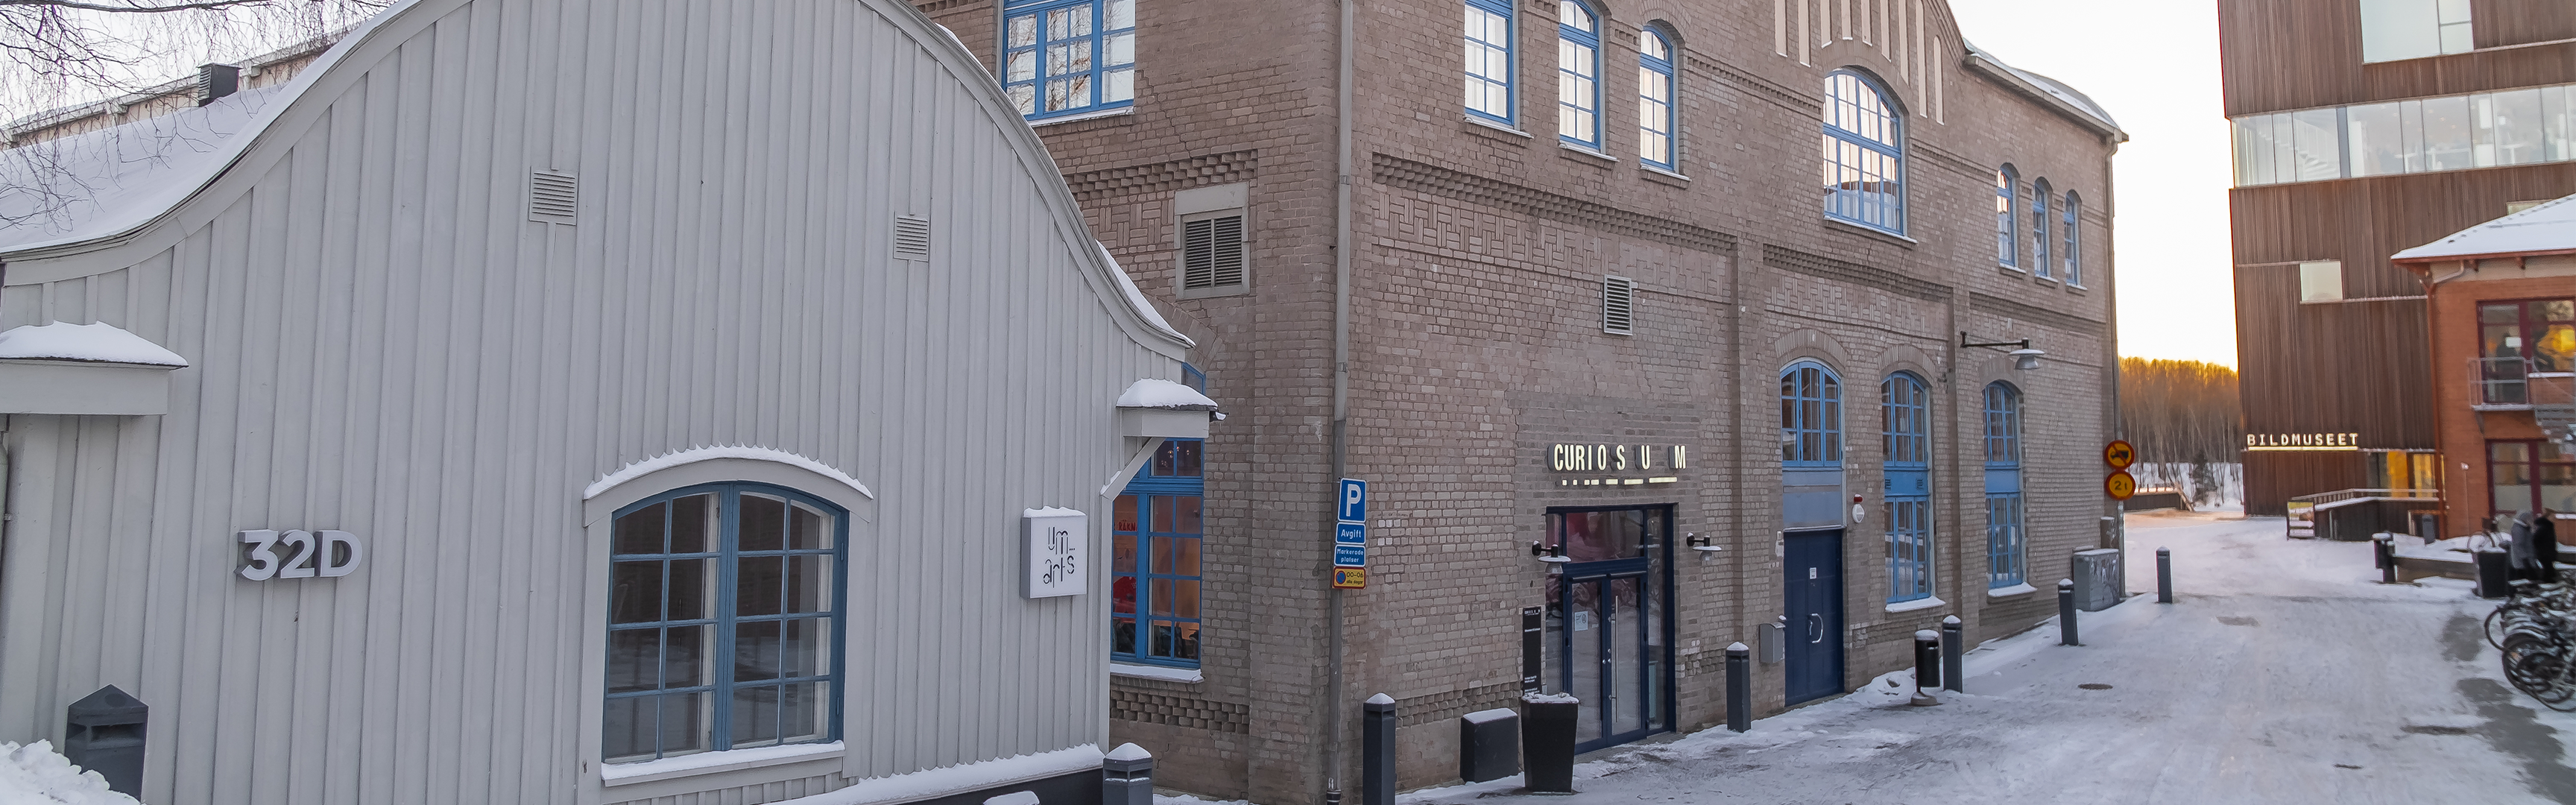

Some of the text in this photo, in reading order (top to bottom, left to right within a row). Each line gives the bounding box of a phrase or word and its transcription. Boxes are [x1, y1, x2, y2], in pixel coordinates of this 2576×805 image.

[2247, 433, 2358, 446] BILDMUSEET
[1346, 484, 1362, 517] P
[1341, 529, 1361, 540] Avgift
[238, 528, 362, 581] 32D
[1336, 548, 1364, 556] Markerade
